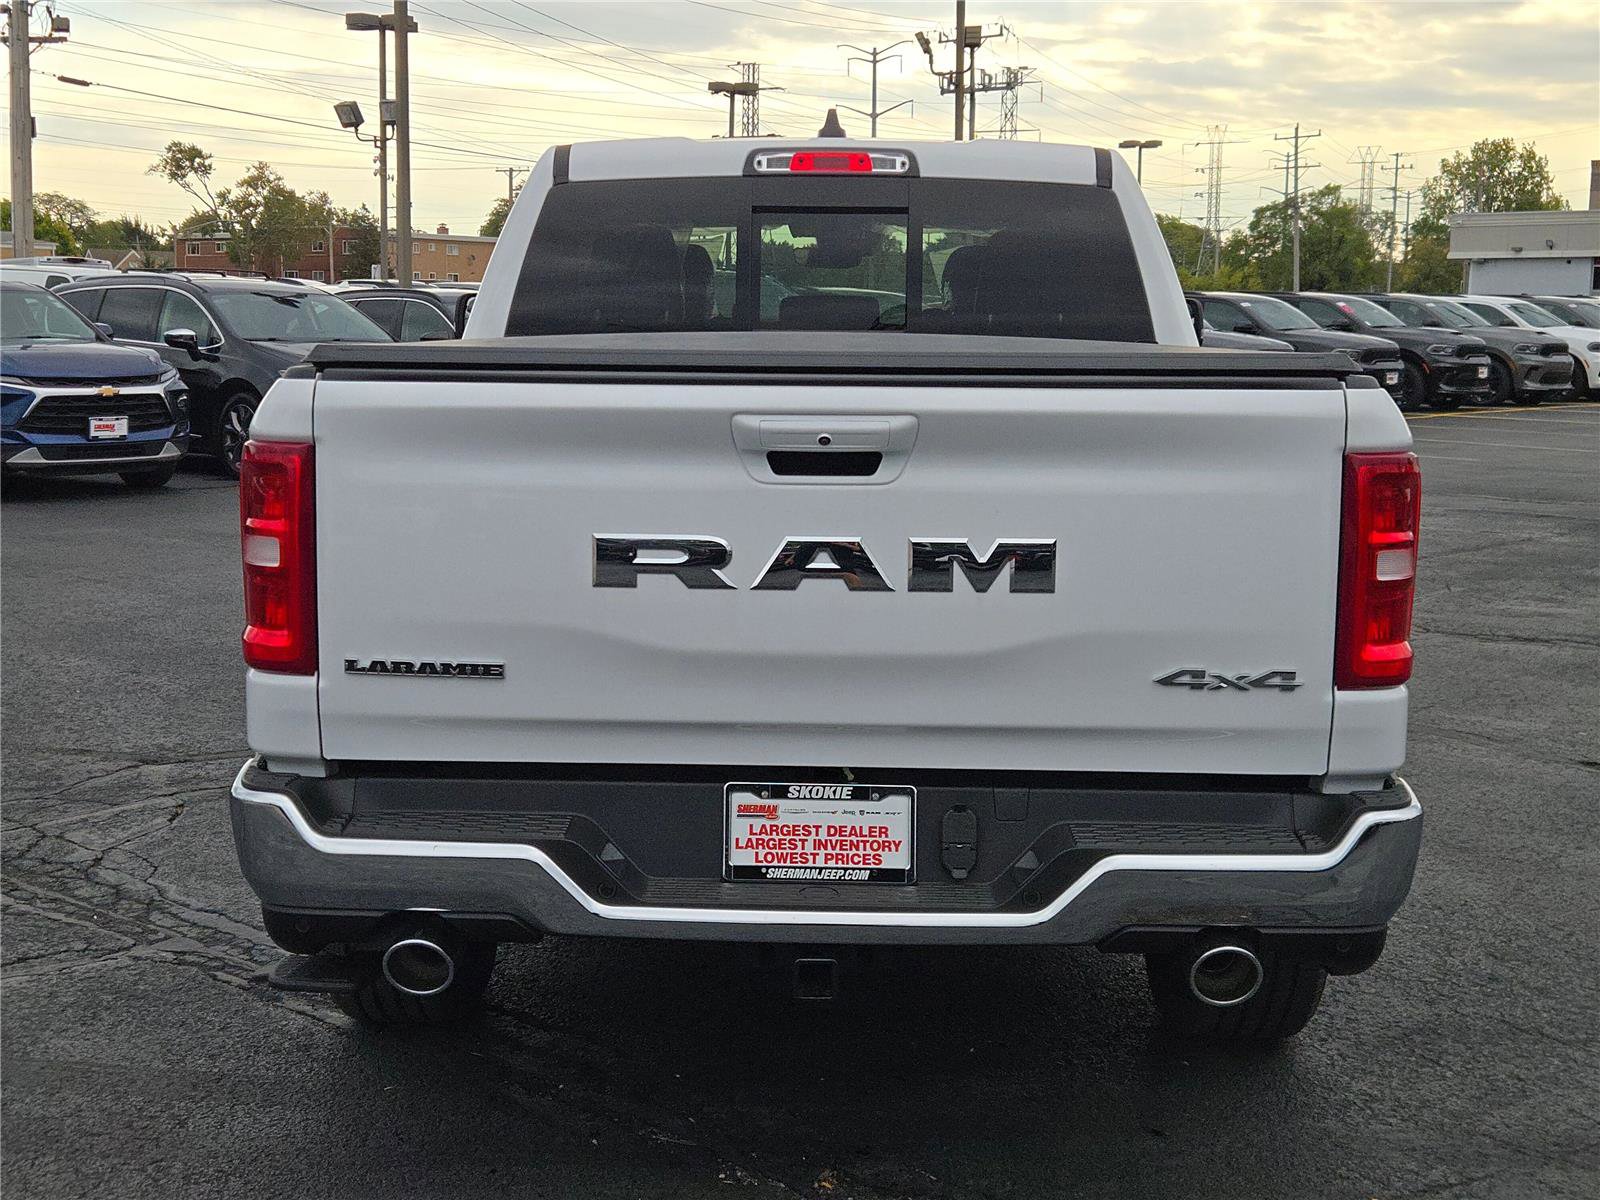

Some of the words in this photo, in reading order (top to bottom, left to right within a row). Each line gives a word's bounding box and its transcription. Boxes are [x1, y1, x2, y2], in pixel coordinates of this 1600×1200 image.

[592, 533, 1057, 593] RAM
[344, 659, 505, 679] LARAMIE
[787, 785, 853, 799] SKOKIE
[736, 804, 778, 814] SHERMAN
[749, 824, 822, 837] LARGEST
[827, 825, 889, 838] DEALER
[735, 838, 808, 850] LARGEST
[813, 839, 902, 852] INVENTORY
[754, 852, 819, 864] LOWEST
[824, 853, 883, 866] PRICES
[766, 868, 870, 880] SHERMANJEEP.COM
